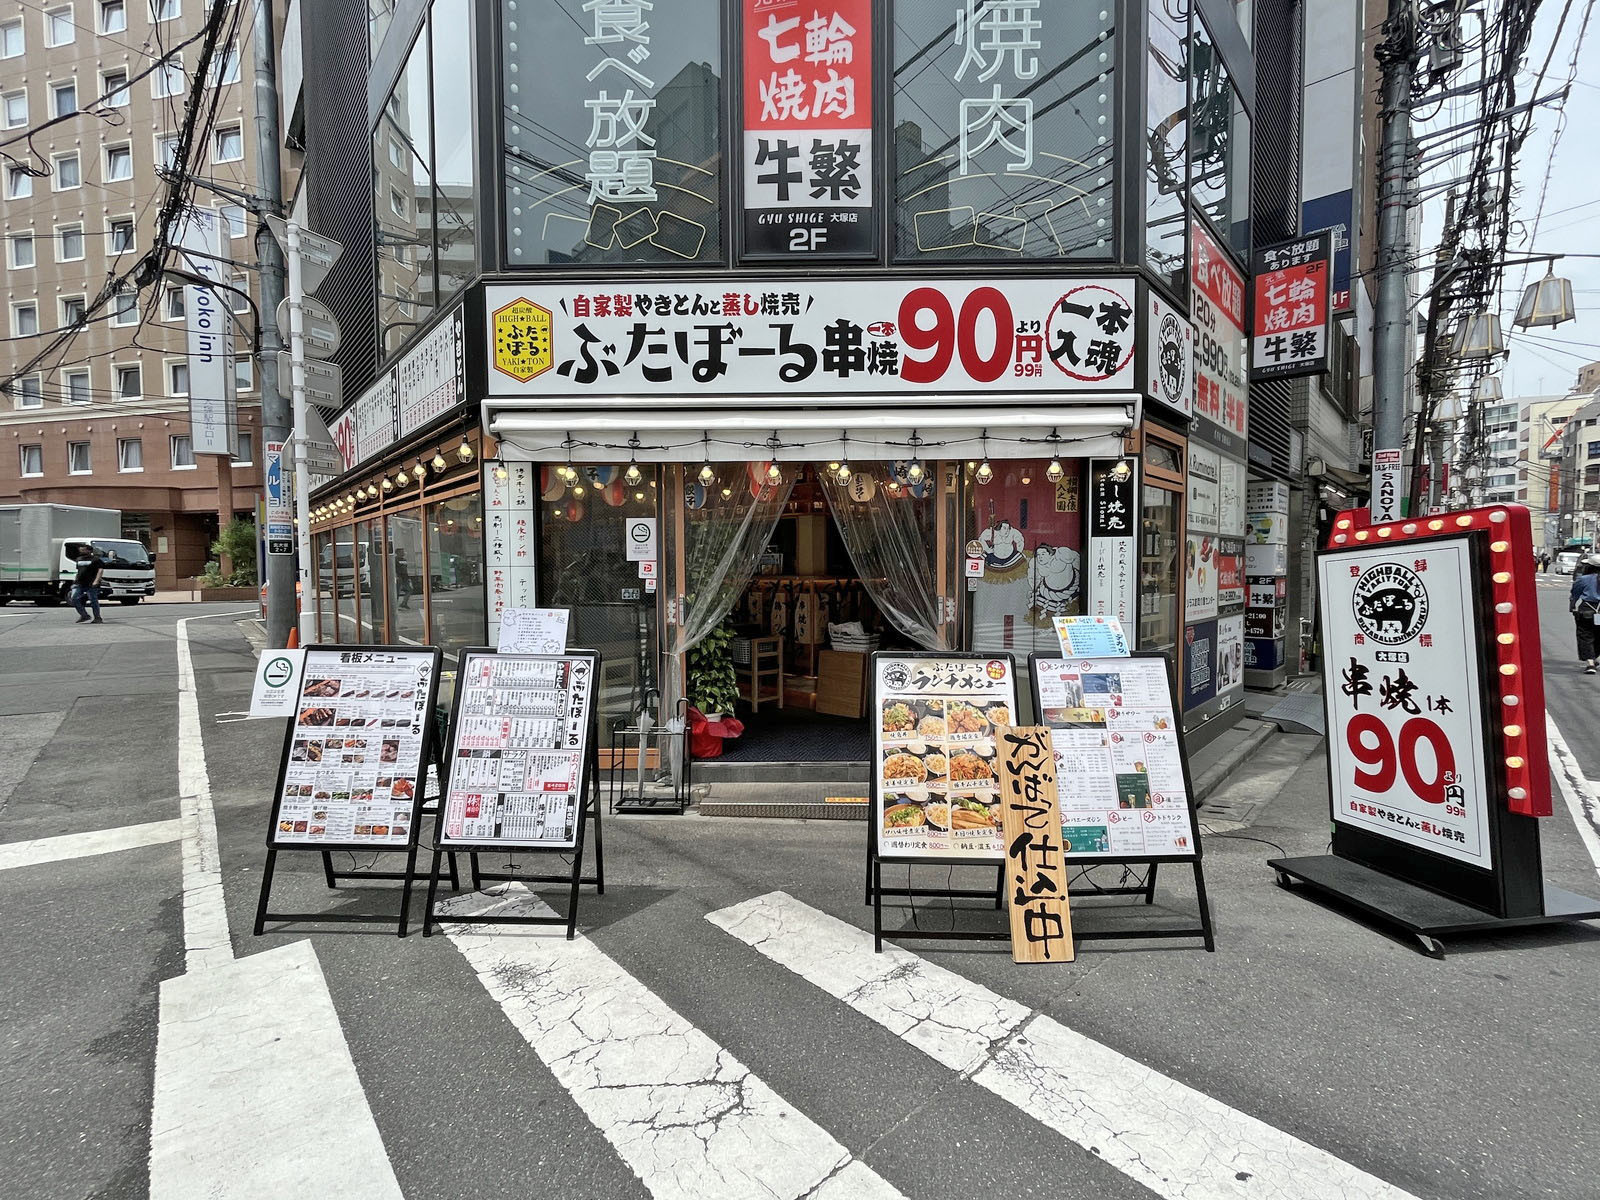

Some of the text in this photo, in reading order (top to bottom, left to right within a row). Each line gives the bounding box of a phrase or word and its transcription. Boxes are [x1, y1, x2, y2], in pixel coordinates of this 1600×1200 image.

[757, 8, 857, 65] 七輪
[758, 68, 856, 122] 焼肉
[953, 0, 1042, 176] 焼肉
[755, 138, 861, 201] 牛繁
[758, 213, 858, 225] GYU SHIGE 大塚店
[789, 227, 828, 251] 2F
[1264, 239, 1320, 263] 食べ放題
[1270, 253, 1313, 270] あります
[1305, 262, 1324, 274] 2F
[572, 292, 801, 318] 自家製やきとんと蒸し焼売
[1264, 276, 1317, 306] 七輪
[499, 315, 547, 323] HIGH BALL
[1016, 320, 1041, 333] より
[1060, 299, 1133, 336] 一本
[1264, 302, 1316, 333] 焼肉
[199, 335, 216, 363] inn
[897, 286, 1015, 384] 90
[1015, 334, 1044, 363] 円
[1264, 331, 1318, 361] 牛繁
[502, 357, 545, 366] YAKI TON
[556, 322, 818, 385] ぶたぼーる
[1050, 329, 1123, 377] 入魂
[267, 453, 280, 508] マルヨ
[1381, 472, 1394, 521] SANOYA
[1358, 566, 1416, 592] HIGHBALL
[1365, 575, 1411, 594] YAKITTON
[1251, 593, 1274, 605] 牛繁
[340, 652, 408, 664] 看板メニュー
[911, 669, 1007, 690] ランチメニュー
[1341, 657, 1454, 716] 串焼 1本
[1346, 712, 1457, 805] 90
[1444, 770, 1462, 783] より
[1445, 784, 1466, 808] 円
[1349, 800, 1466, 844] 自家製やきとんと蒸し焼売
